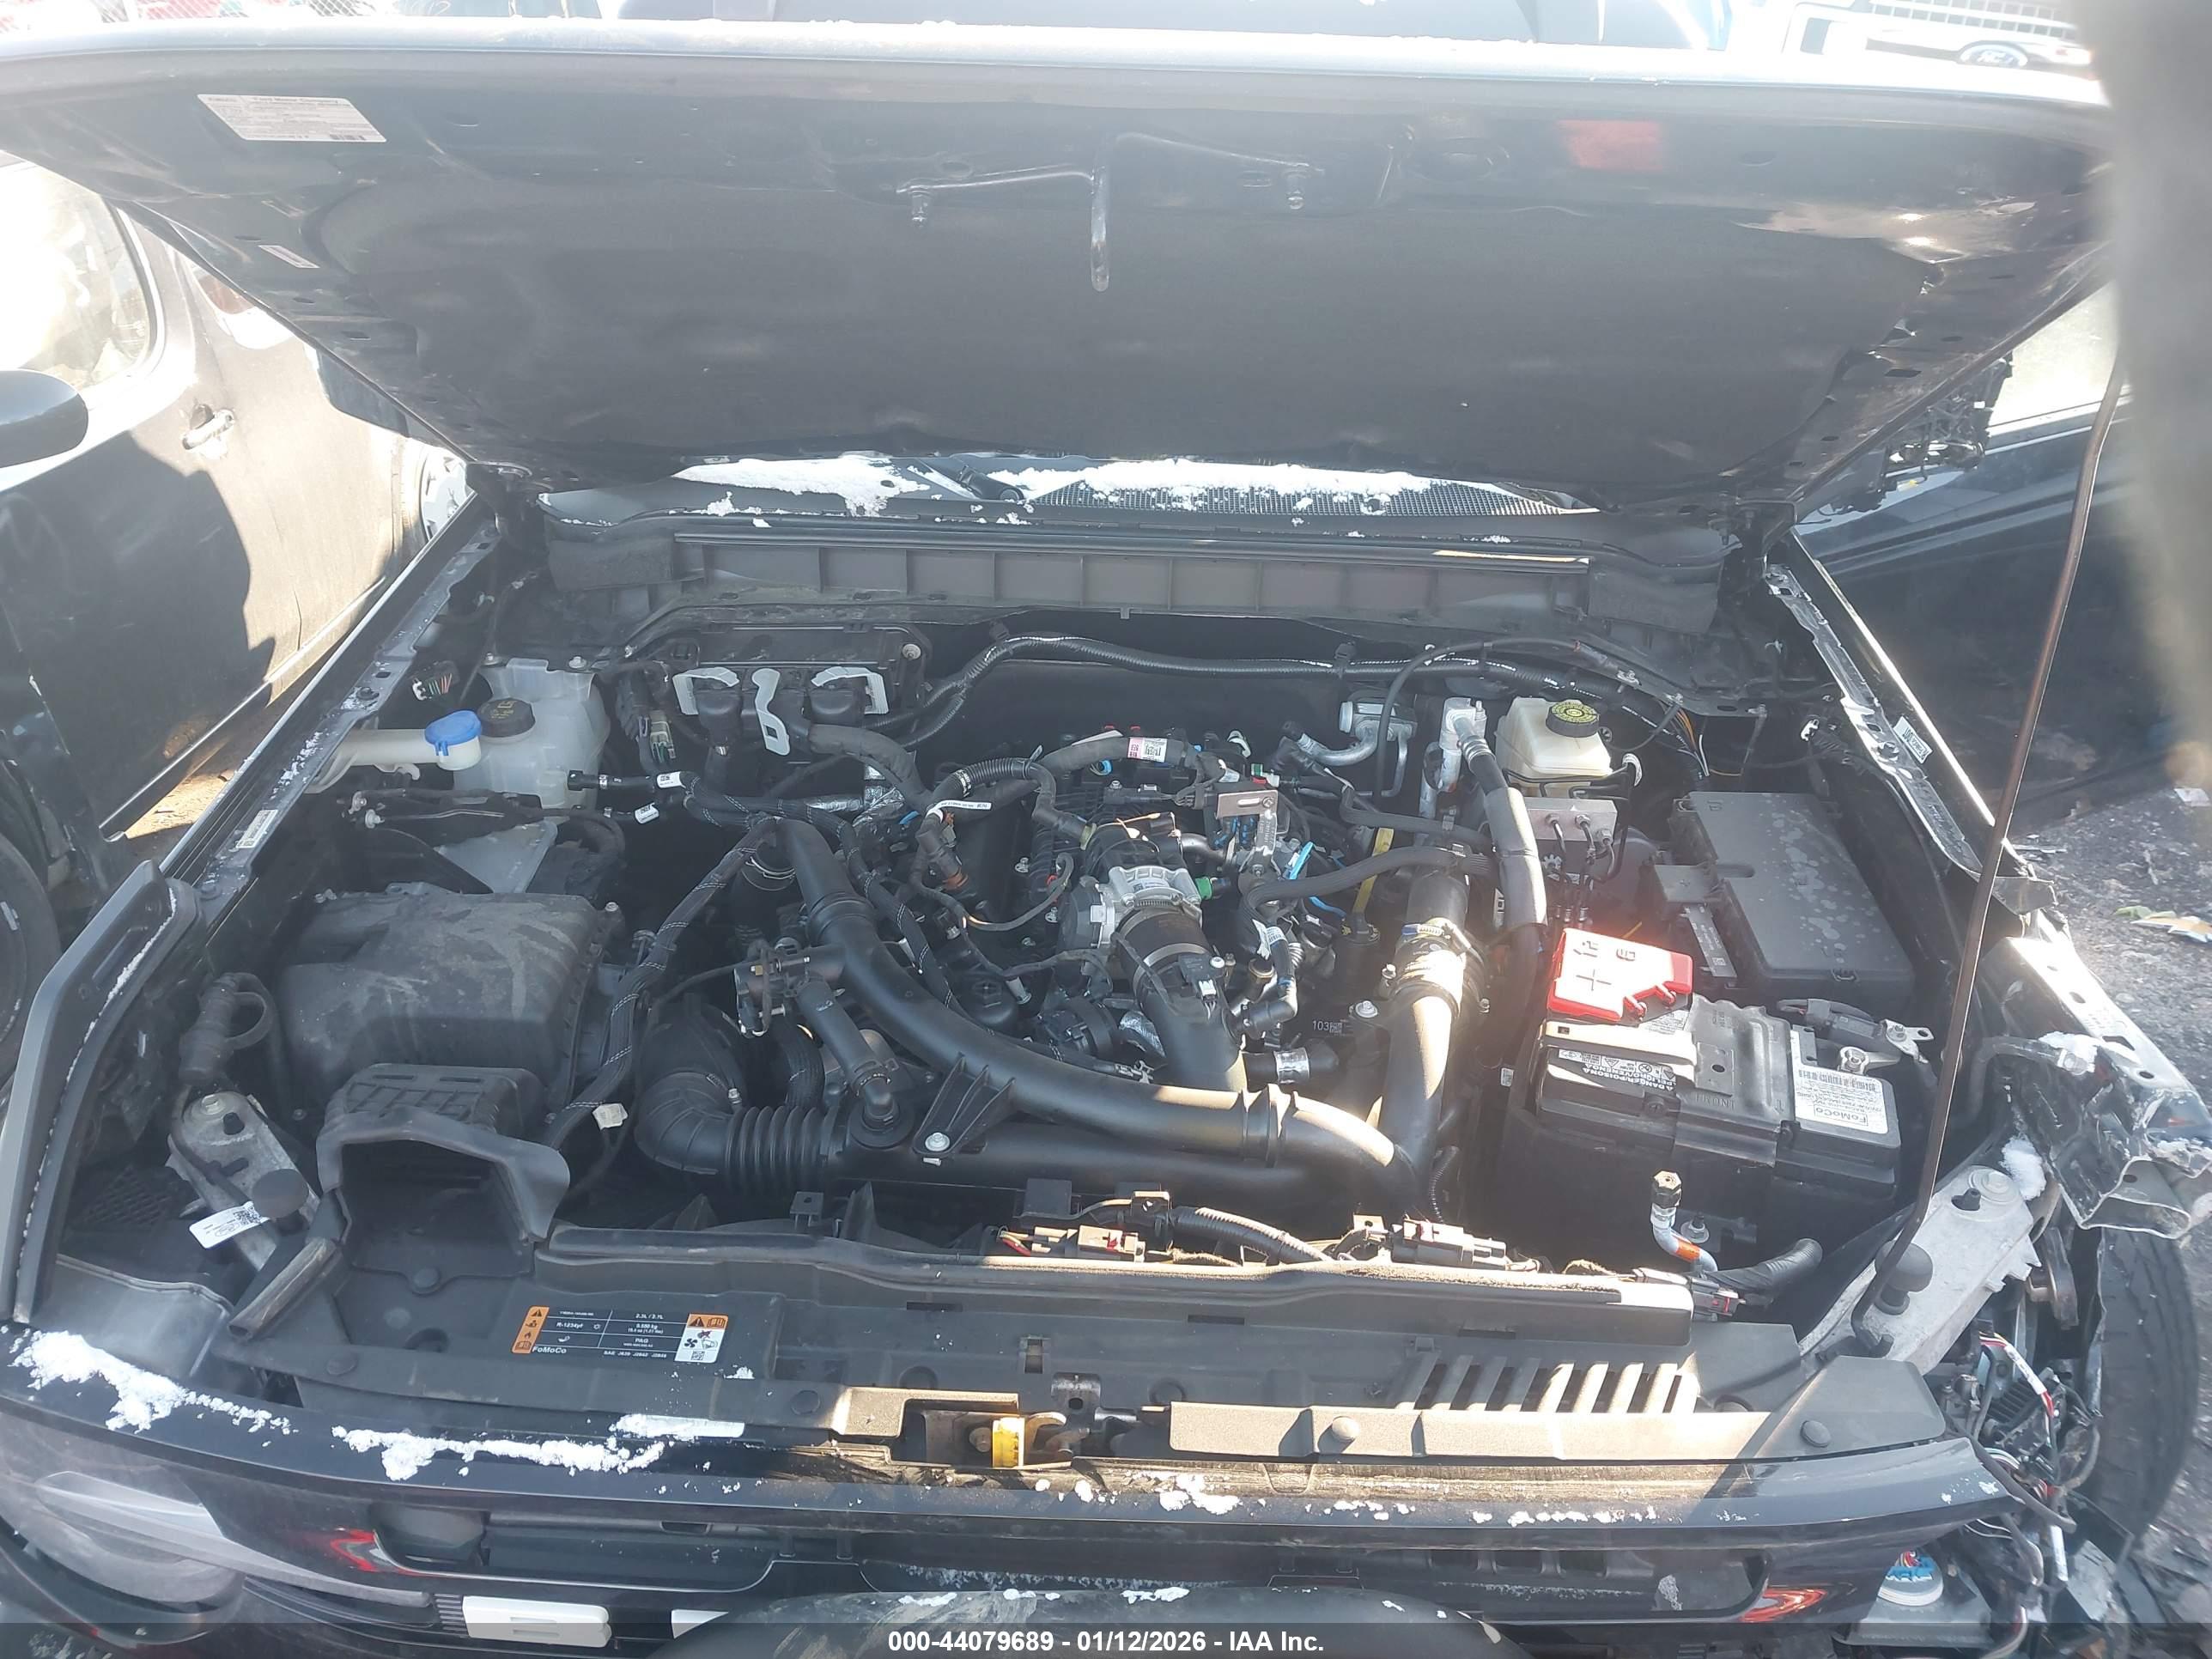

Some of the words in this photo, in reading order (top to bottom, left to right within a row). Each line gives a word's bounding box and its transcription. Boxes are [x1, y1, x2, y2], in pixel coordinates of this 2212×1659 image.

[1589, 1068, 1666, 1091] DANGER/POISON
[1815, 1107, 1866, 1123] FoMoCo
[532, 1346, 568, 1354] FoMoCo
